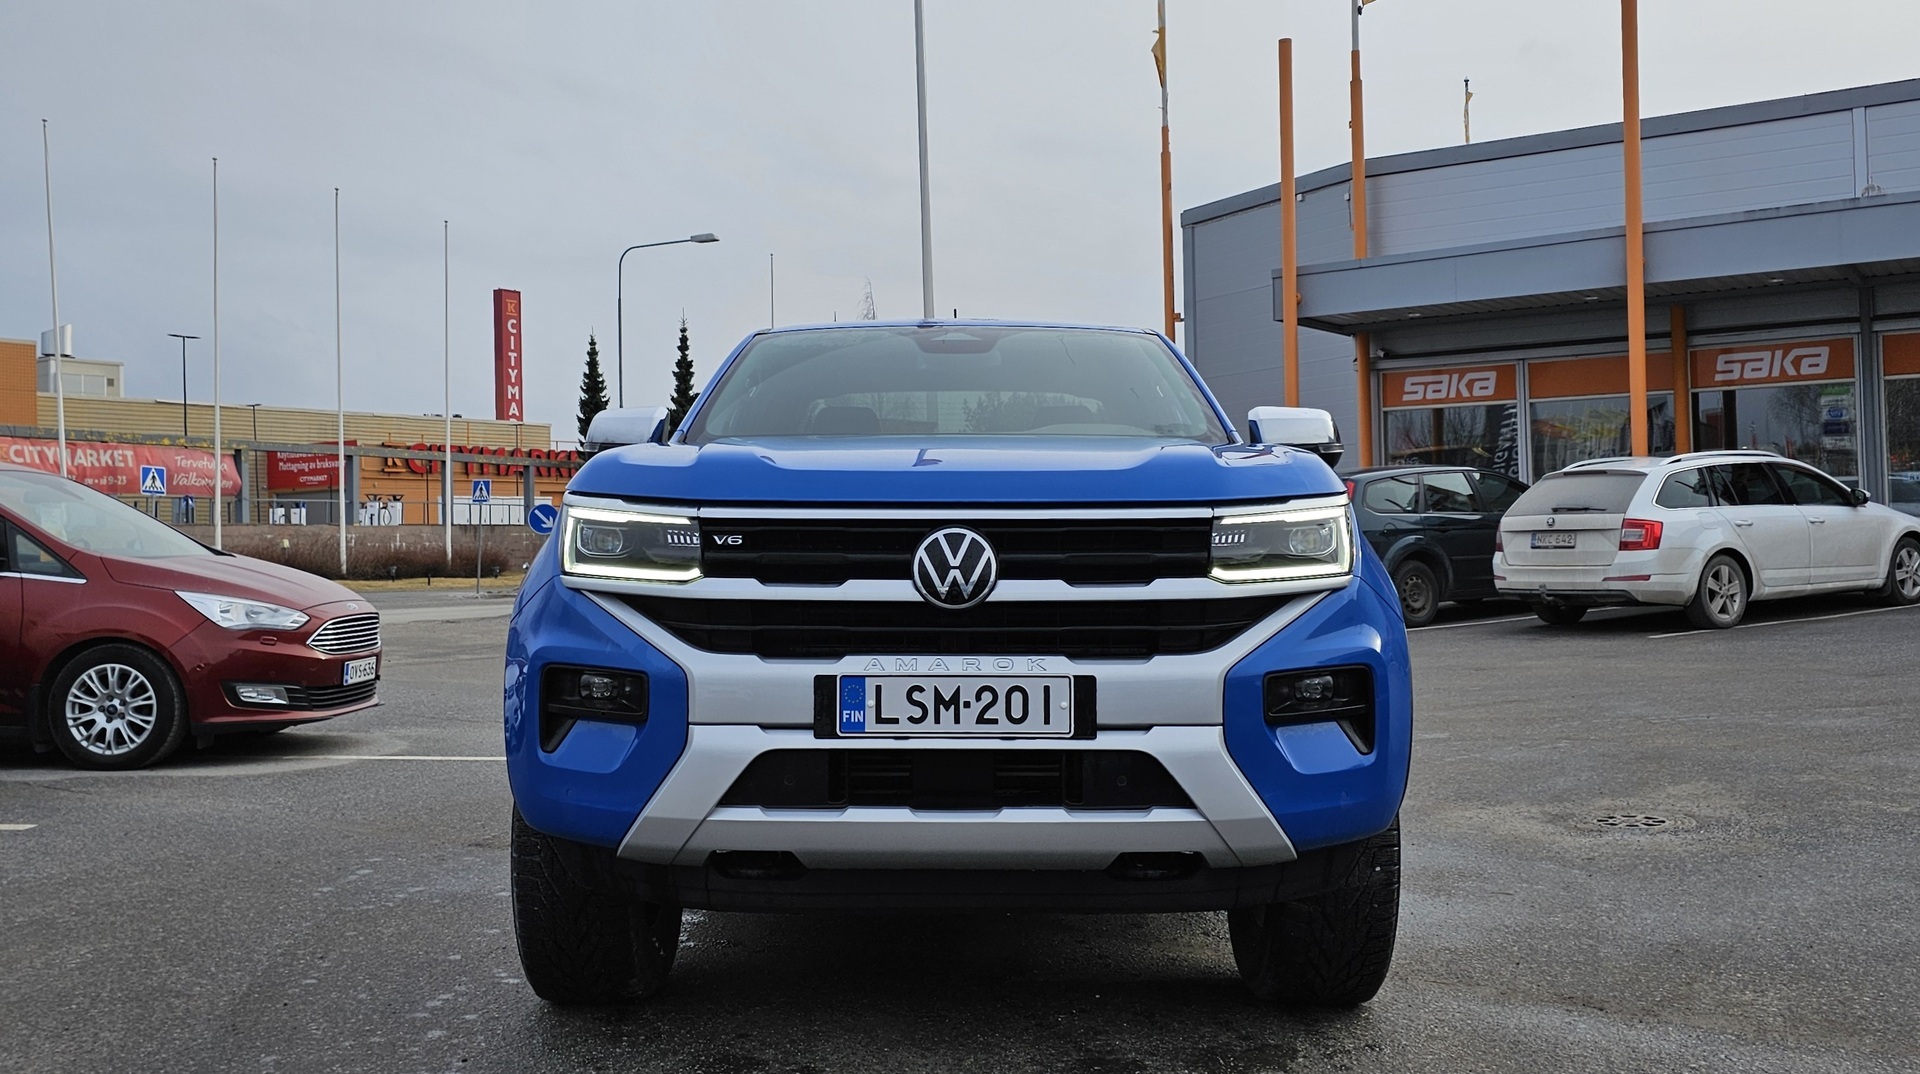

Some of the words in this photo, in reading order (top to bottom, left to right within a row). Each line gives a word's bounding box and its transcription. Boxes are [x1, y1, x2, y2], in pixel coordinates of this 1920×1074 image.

[713, 535, 743, 545] V6
[864, 658, 1047, 671] AMAROK
[842, 711, 864, 722] FIN
